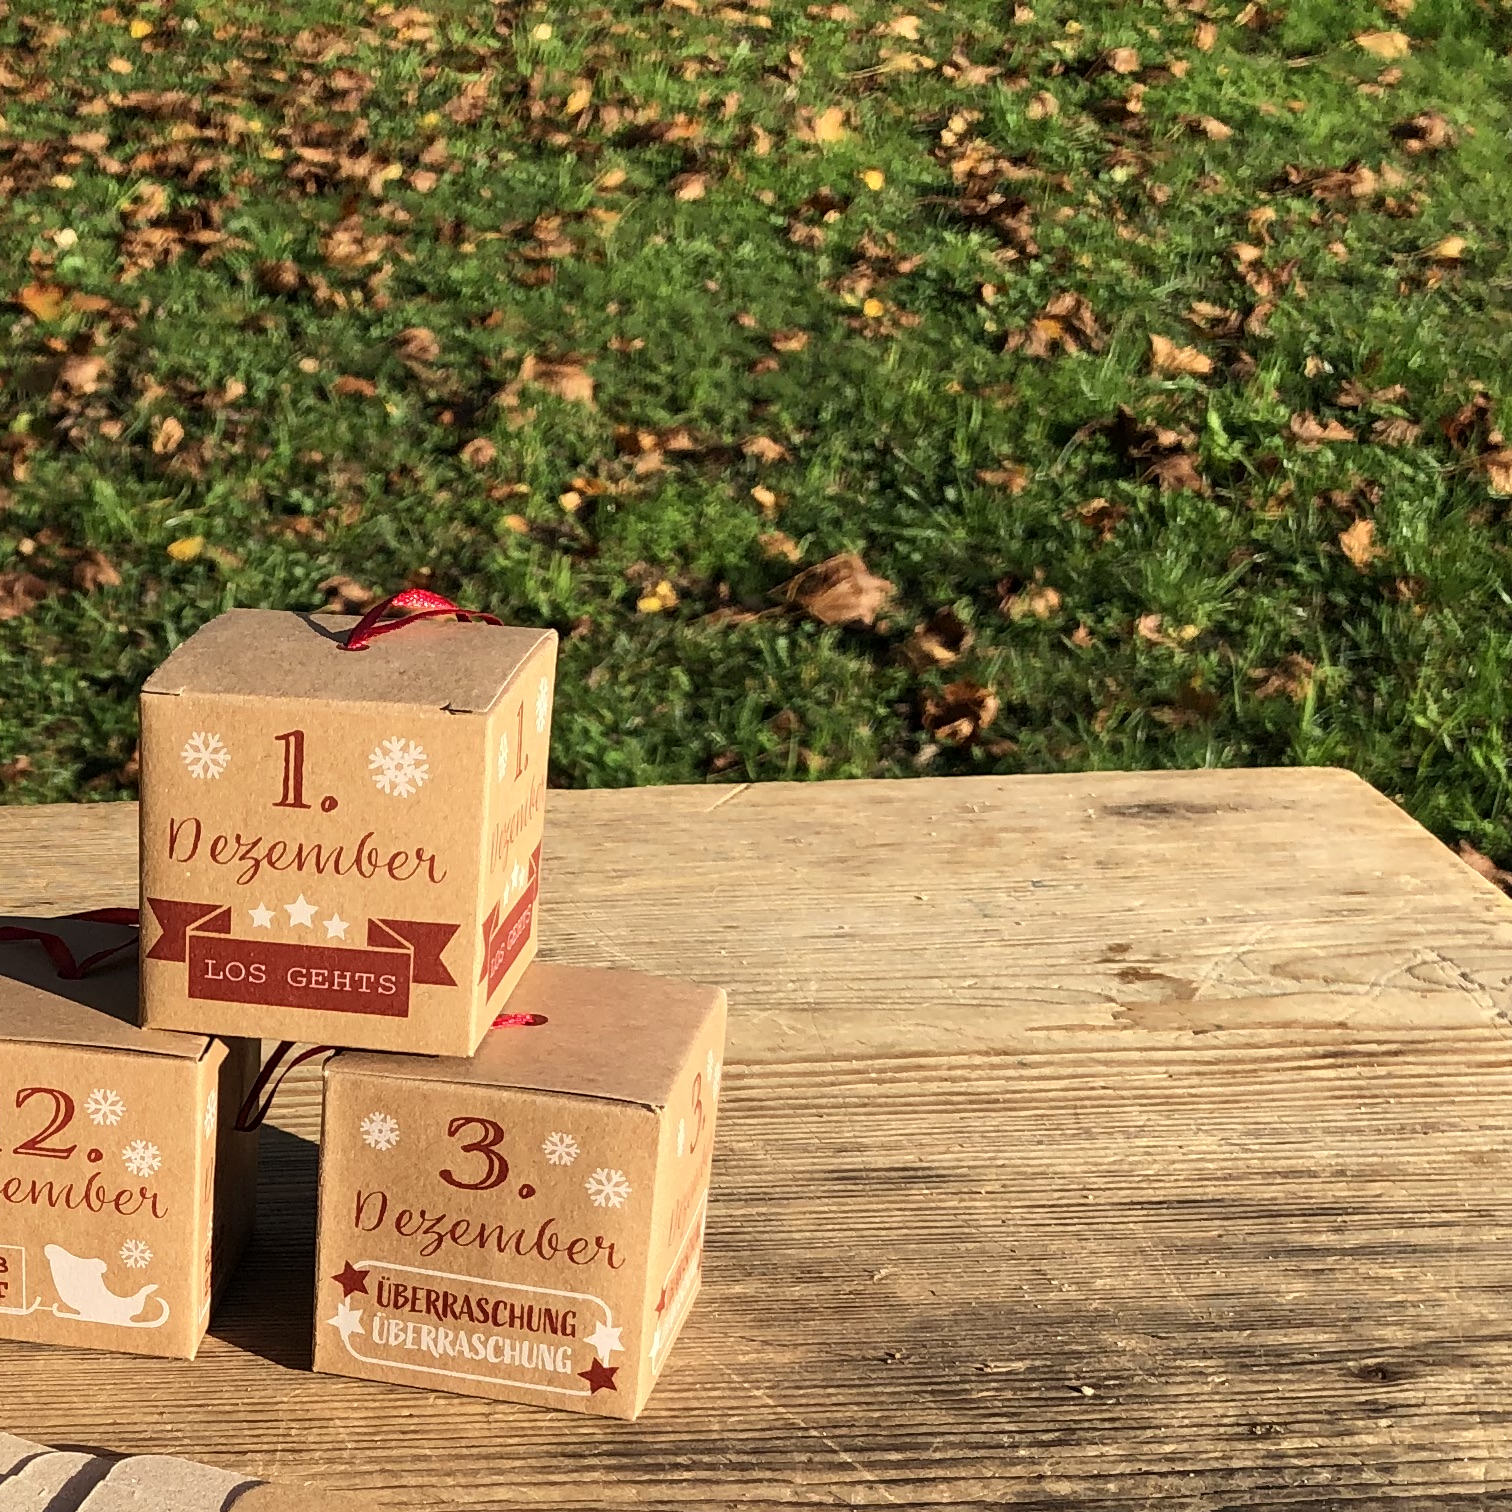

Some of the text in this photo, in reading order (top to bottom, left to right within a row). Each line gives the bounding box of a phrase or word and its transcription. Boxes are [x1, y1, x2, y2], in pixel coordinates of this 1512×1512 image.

[272, 729, 338, 813] 1.
[168, 817, 448, 886] Dezember
[204, 958, 398, 995] LOS GEHTS
[438, 1116, 536, 1199] 3.
[354, 1189, 626, 1270] Dezember
[376, 1276, 576, 1338] ÜBERRASCHUNG
[372, 1313, 573, 1374] ÜBERRASCHUNG
